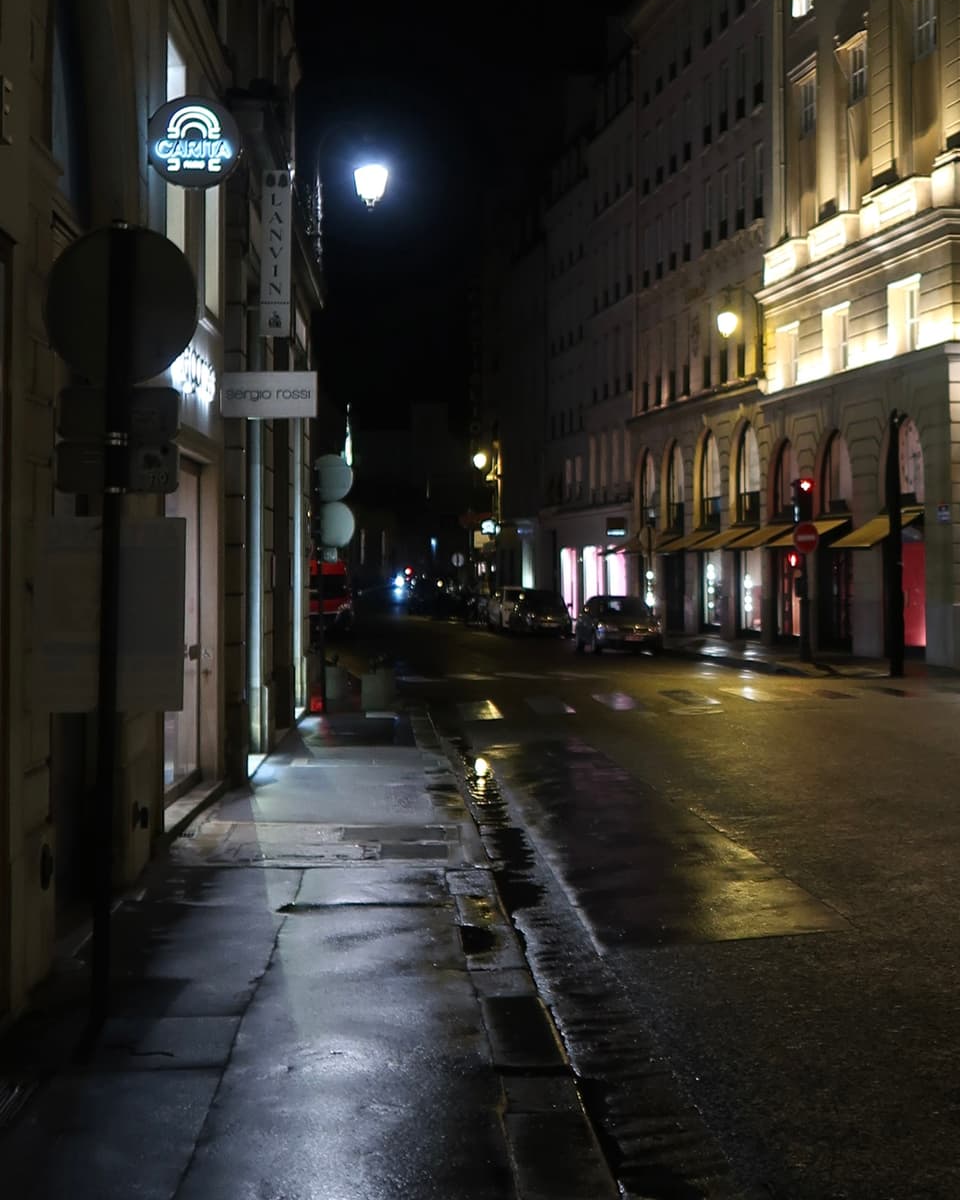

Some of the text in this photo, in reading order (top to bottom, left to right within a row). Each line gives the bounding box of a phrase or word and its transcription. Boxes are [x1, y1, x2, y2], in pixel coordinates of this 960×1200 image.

[155, 138, 233, 159] CARITA
[268, 192, 283, 296] LANVIN
[225, 388, 312, 401] sergio rossi
